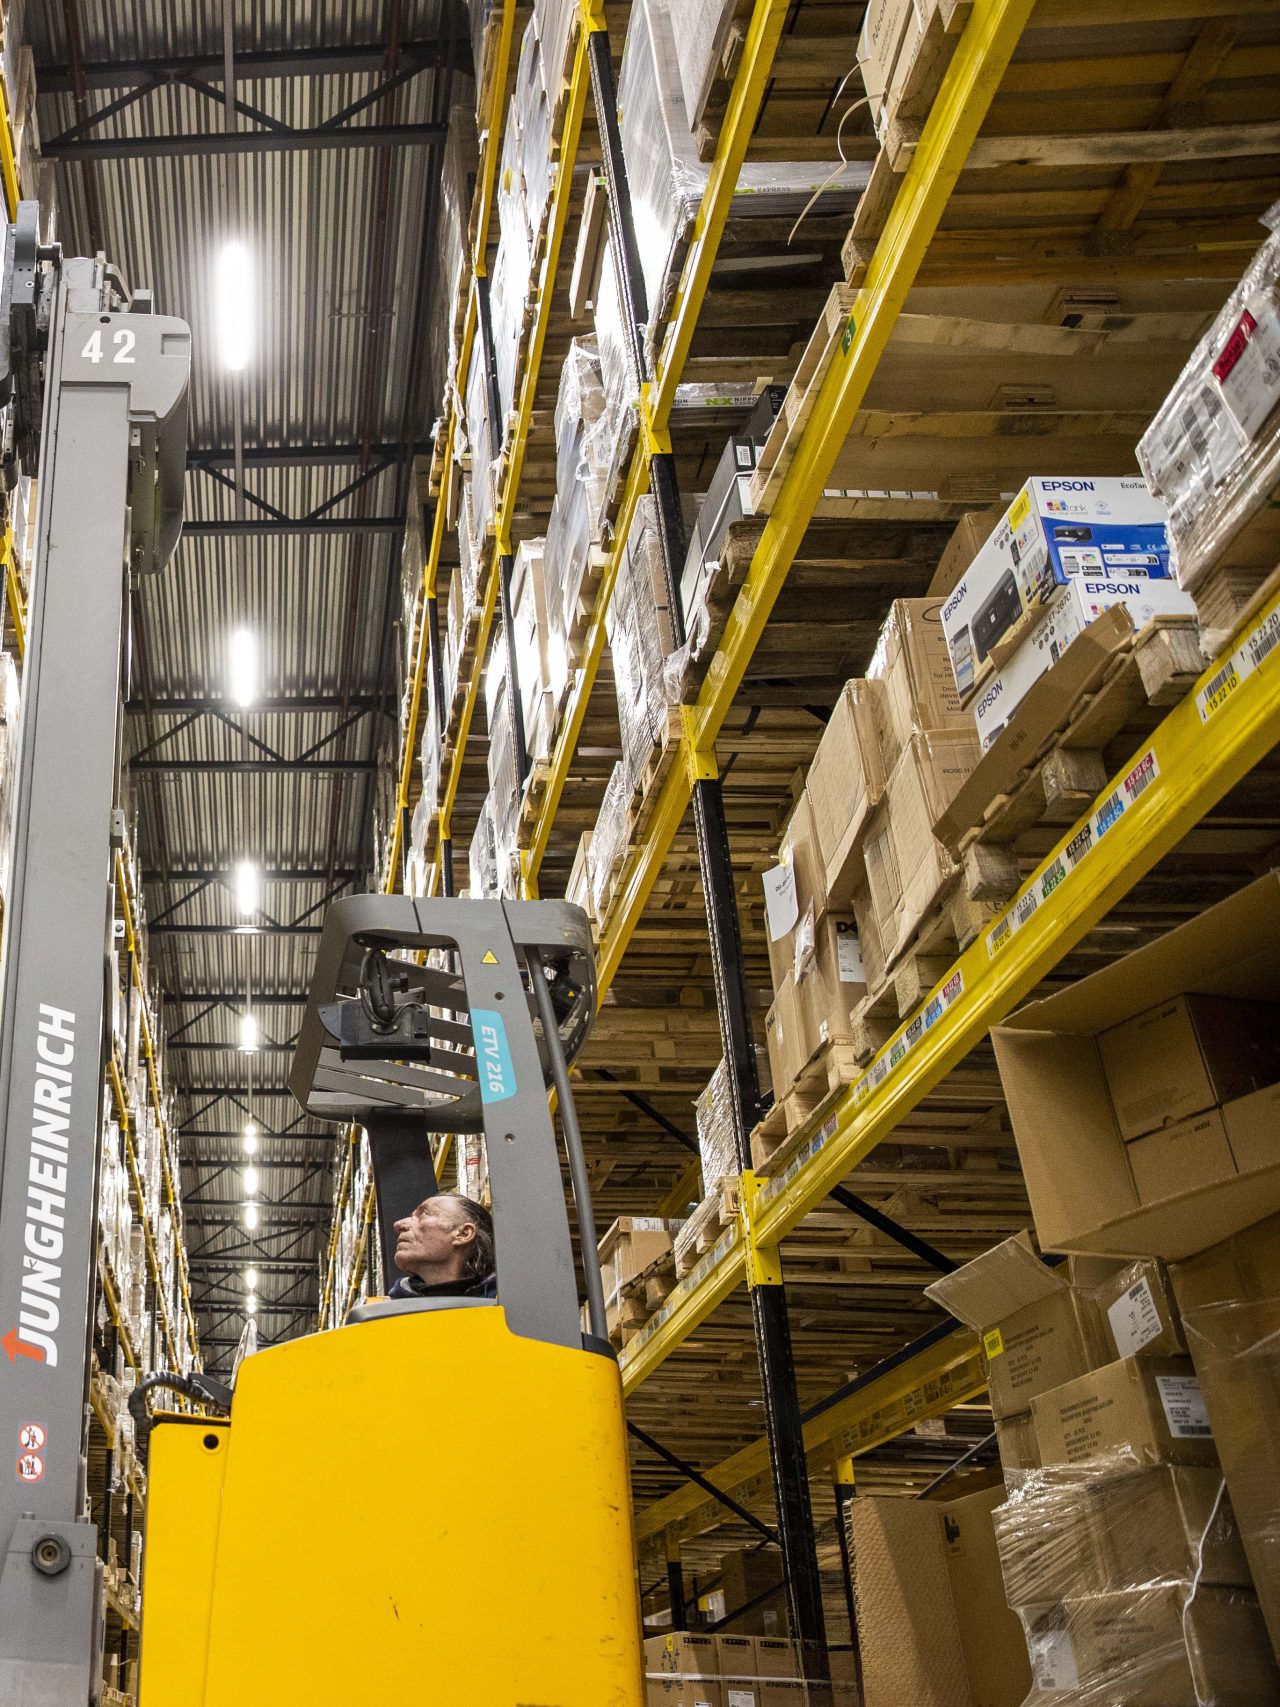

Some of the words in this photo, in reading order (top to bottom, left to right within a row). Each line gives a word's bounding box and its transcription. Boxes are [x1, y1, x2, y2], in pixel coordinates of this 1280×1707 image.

[80, 329, 136, 363] 42
[1041, 480, 1095, 492] EPSON
[942, 582, 968, 622] EPSON
[1086, 583, 1141, 595] EPSON
[1031, 621, 1049, 646] EcoTank
[977, 679, 1004, 719] EPSON
[1209, 700, 1218, 712] 15
[1218, 687, 1228, 702] 22
[1227, 677, 1237, 693] 1D
[1126, 776, 1135, 788] 15
[1134, 766, 1143, 779] 22
[481, 1025, 500, 1060] ETV
[486, 1062, 504, 1093] 216
[10, 1003, 76, 1367] JUNGHEINRICH
